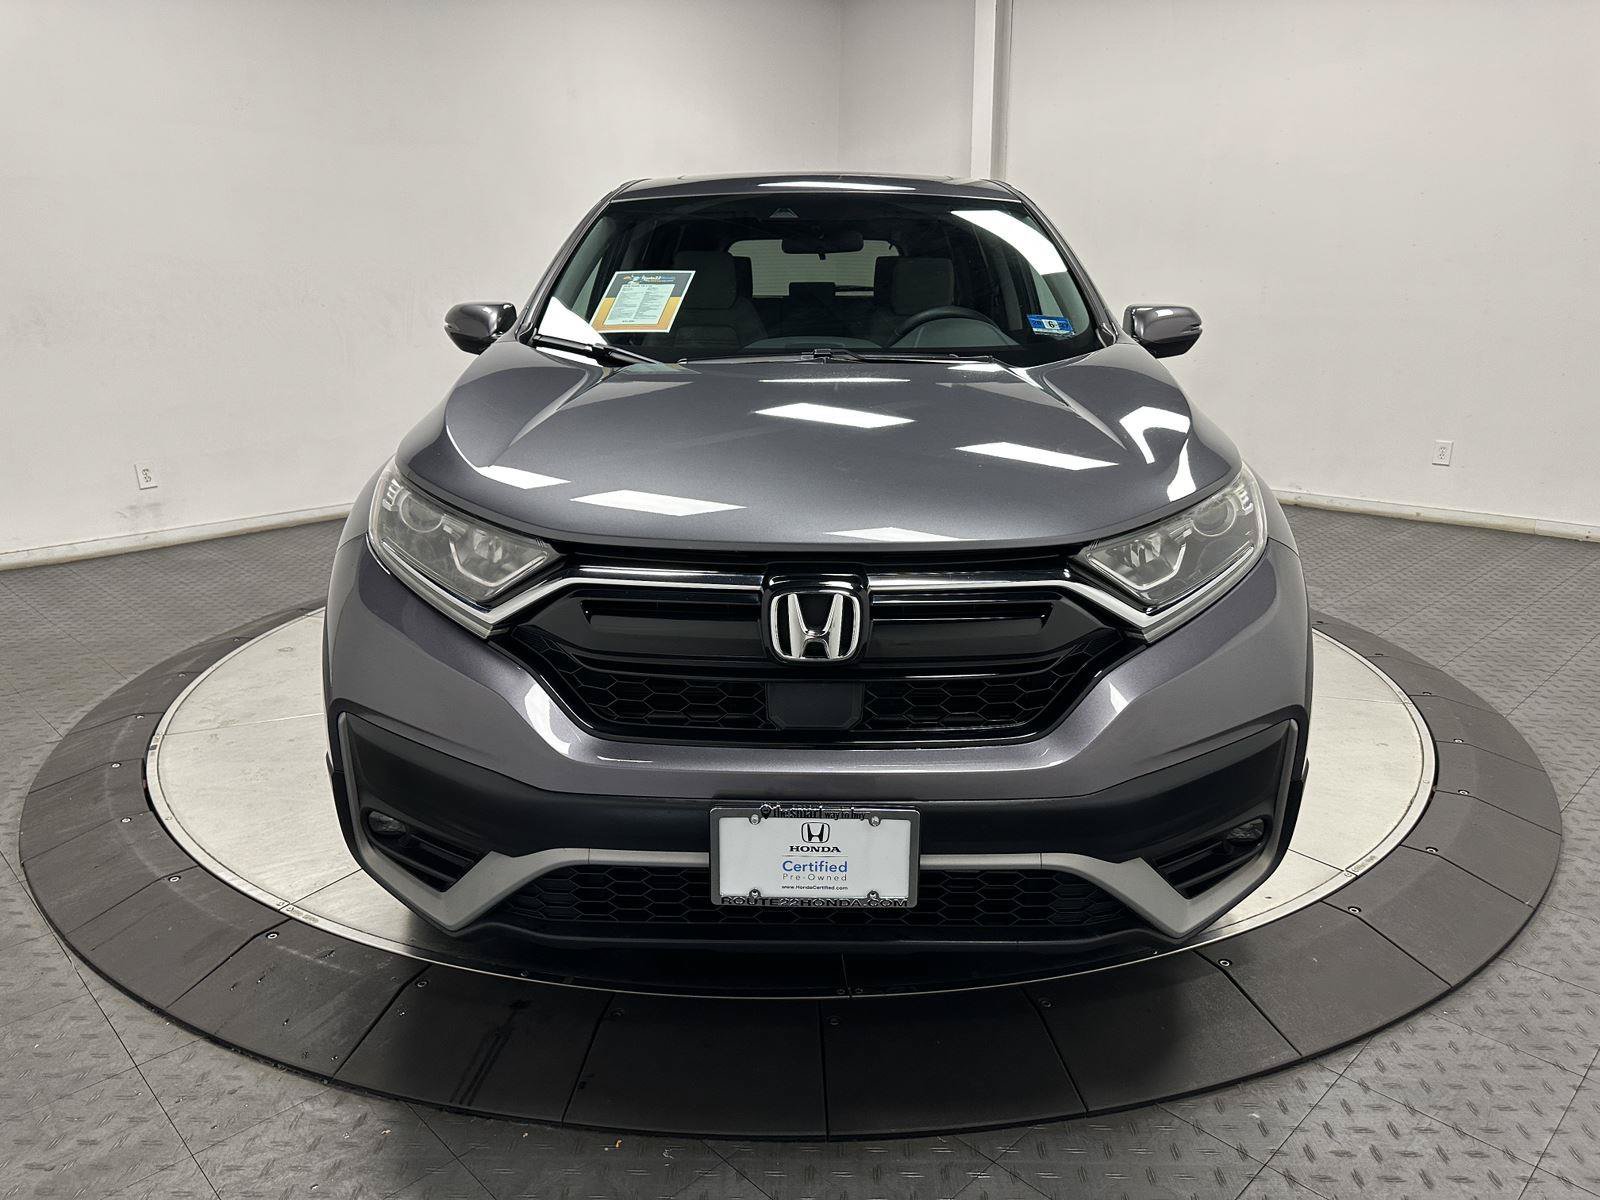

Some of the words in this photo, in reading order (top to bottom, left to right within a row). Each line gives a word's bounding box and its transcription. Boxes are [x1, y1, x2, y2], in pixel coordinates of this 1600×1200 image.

[1048, 320, 1055, 328] 6
[790, 807, 823, 818] smart
[825, 812, 840, 820] way
[782, 860, 848, 872] Certified
[782, 873, 847, 881] Pre-Owned
